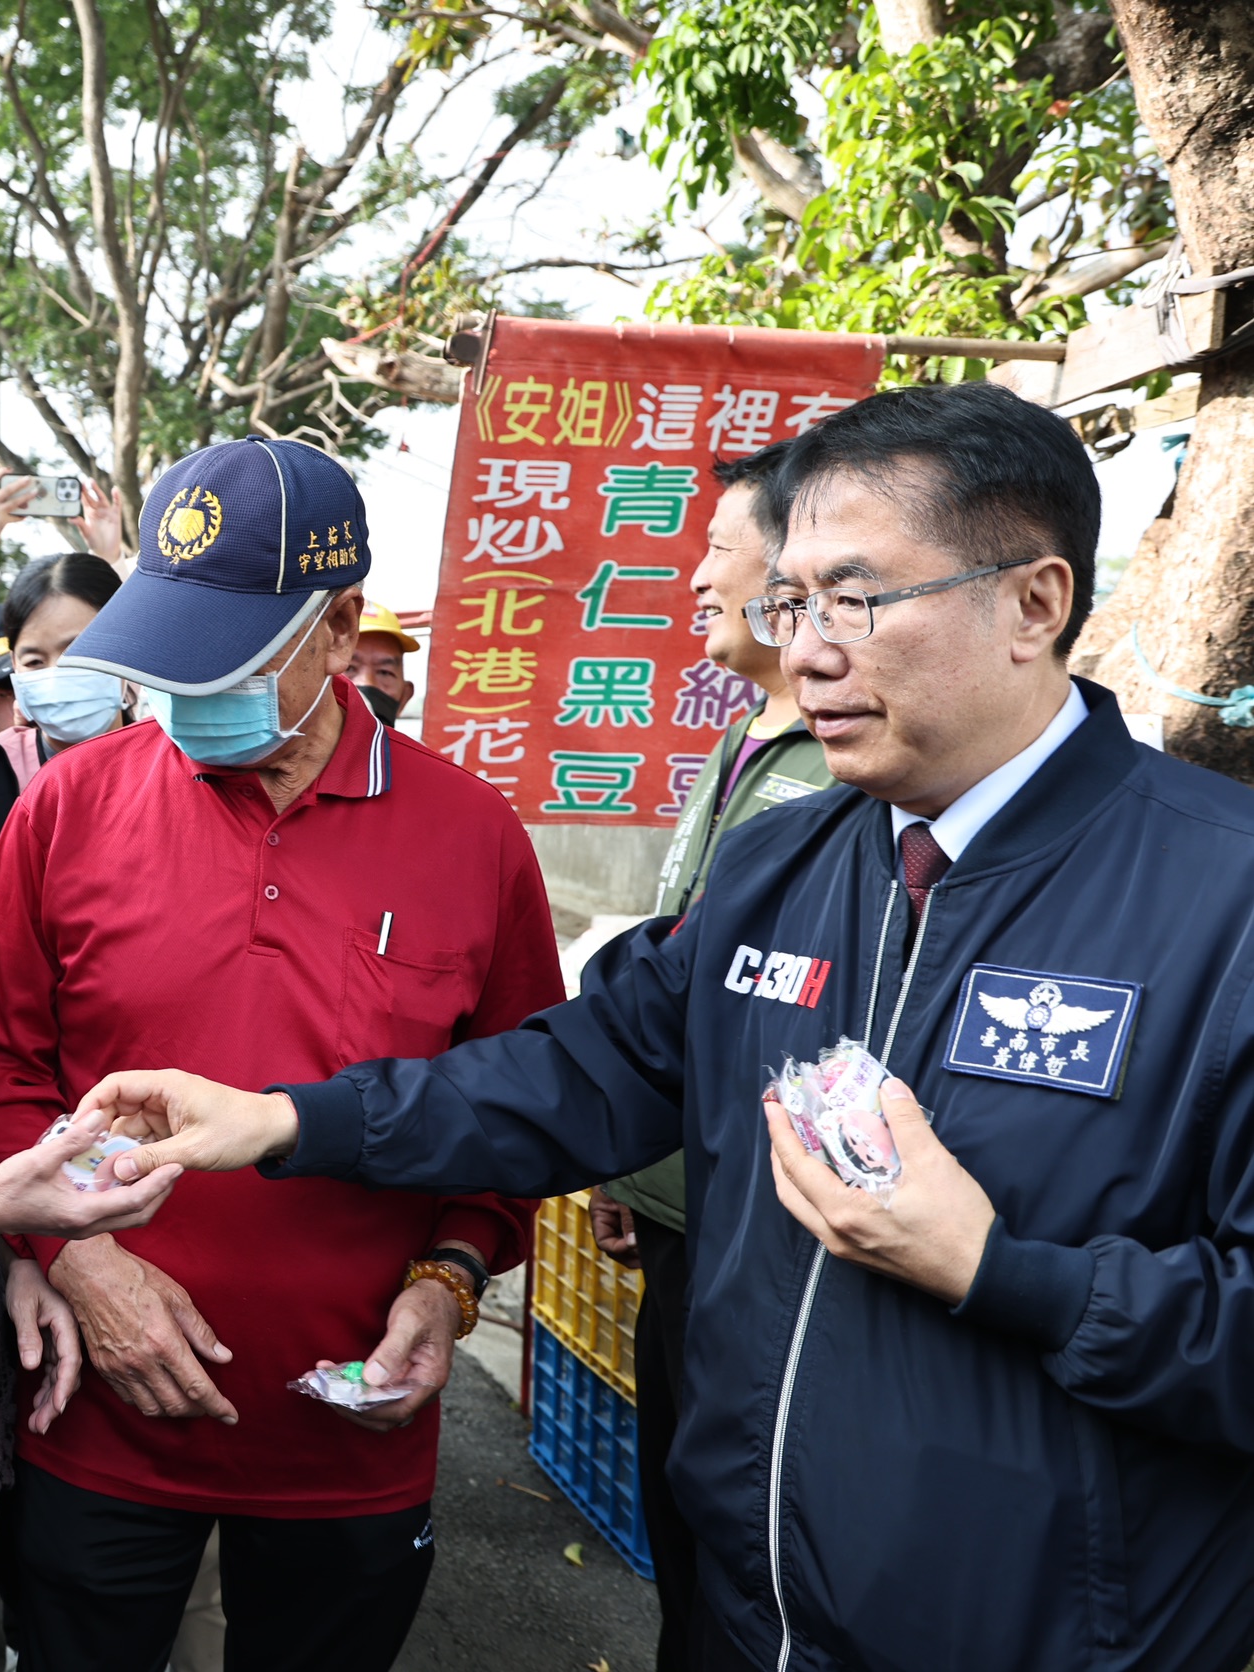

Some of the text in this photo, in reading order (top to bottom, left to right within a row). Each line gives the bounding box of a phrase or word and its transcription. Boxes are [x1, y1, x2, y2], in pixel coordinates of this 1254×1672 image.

[298, 543, 358, 574] 守望相助隊
[541, 461, 699, 814] 青仁黑豆
[724, 944, 832, 1009] C-130H
[980, 1025, 1090, 1062] 臺南市長
[992, 1046, 1068, 1076] 黃偉哲
